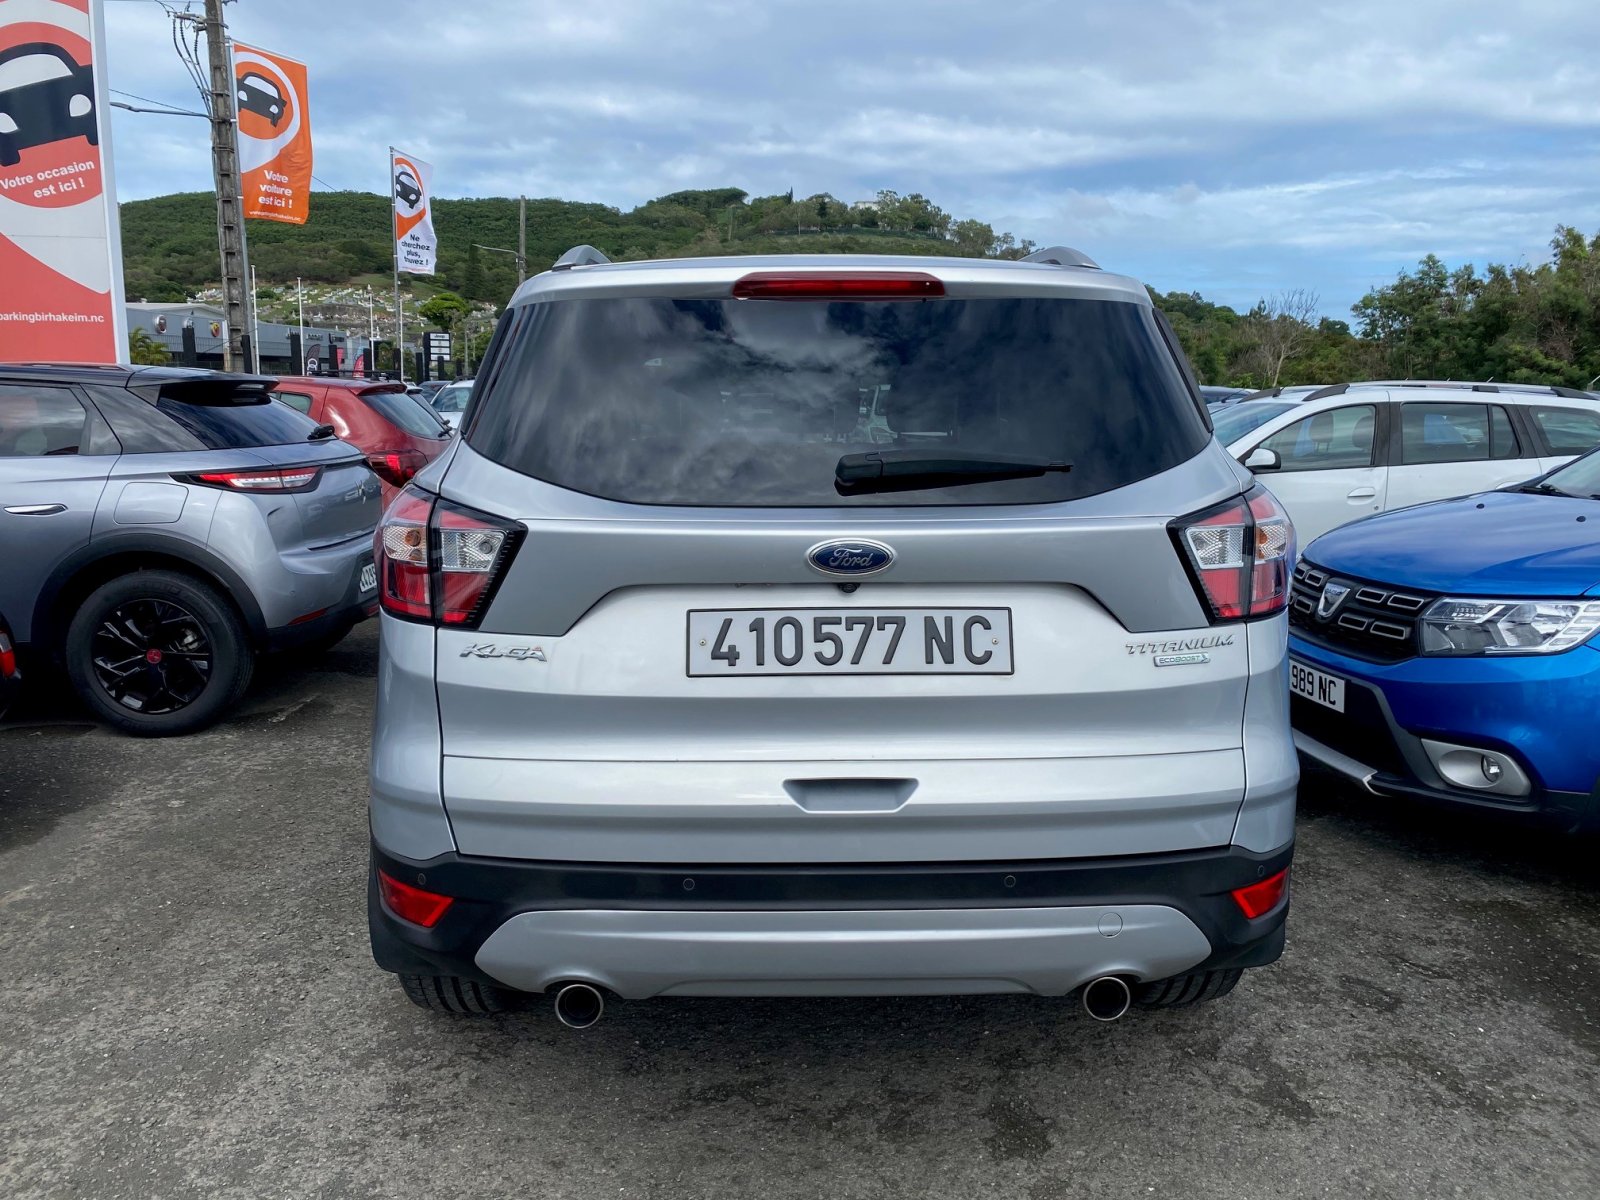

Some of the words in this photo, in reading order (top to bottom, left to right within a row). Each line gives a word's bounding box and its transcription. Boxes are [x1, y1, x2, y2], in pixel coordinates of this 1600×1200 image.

[0, 174, 33, 190] Votre
[37, 160, 95, 181] occasion
[264, 169, 289, 183] Votre
[33, 184, 56, 198] est
[58, 179, 77, 192] ici
[260, 184, 293, 196] voiture
[258, 196, 273, 205] est
[273, 198, 285, 207] ici
[410, 233, 420, 242] Ne
[828, 547, 873, 567] Ford
[710, 615, 907, 667] 410577
[923, 614, 994, 666] NC
[1125, 634, 1235, 655] TITANIUM
[1159, 655, 1201, 664] ECOBOOST
[1291, 664, 1315, 697] 989
[1318, 675, 1337, 706] NC
